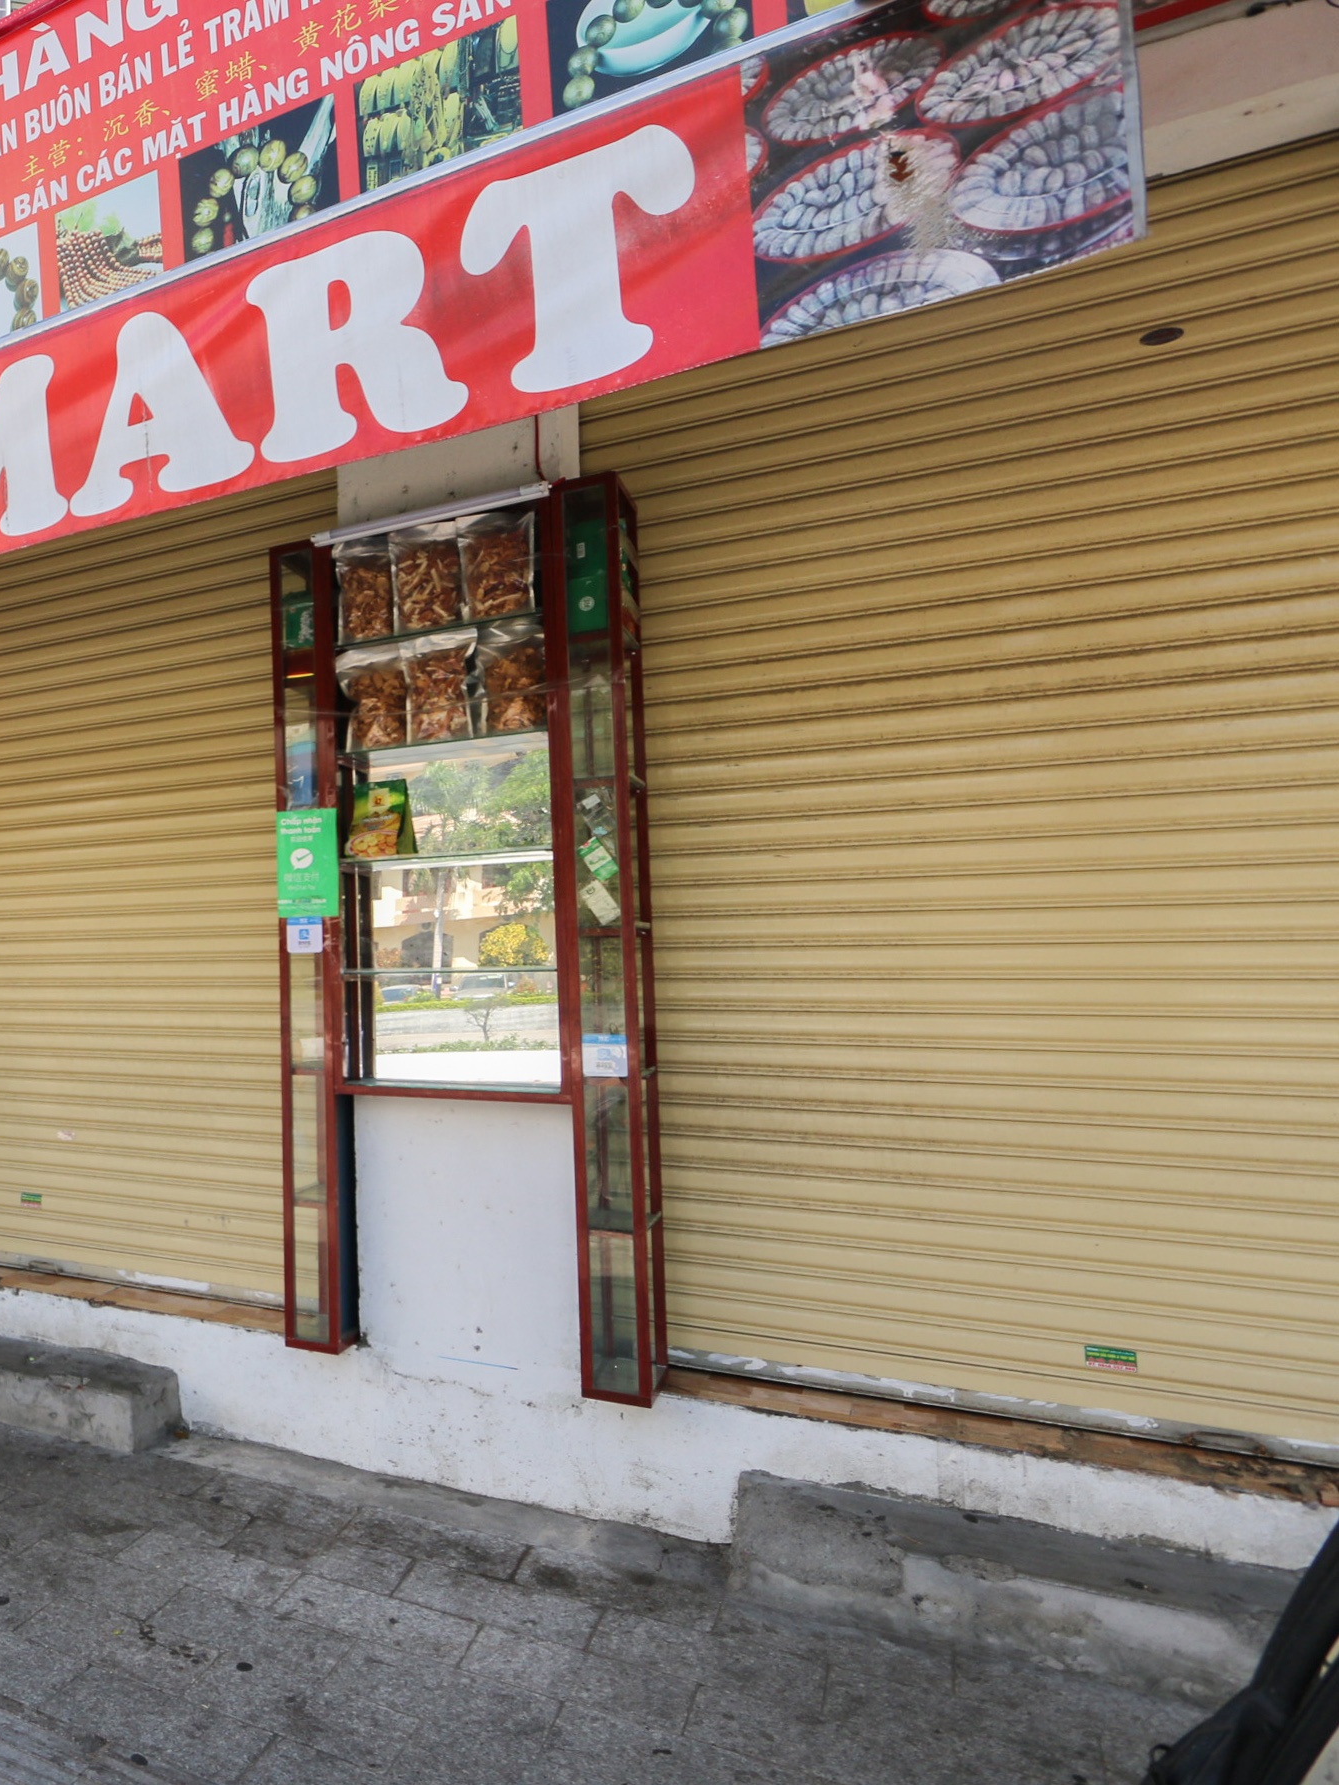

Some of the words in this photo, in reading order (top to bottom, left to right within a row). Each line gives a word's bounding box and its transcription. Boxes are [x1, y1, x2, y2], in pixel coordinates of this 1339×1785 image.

[13, 174, 69, 222] BÁN
[76, 147, 134, 193] CÁC
[142, 112, 207, 160] MẶT
[218, 66, 310, 132] HÀNG
[319, 18, 421, 87] NÔNG
[25, 82, 91, 143] BUÔN
[98, 51, 153, 107] BÁN
[160, 19, 195, 77] LẺ
